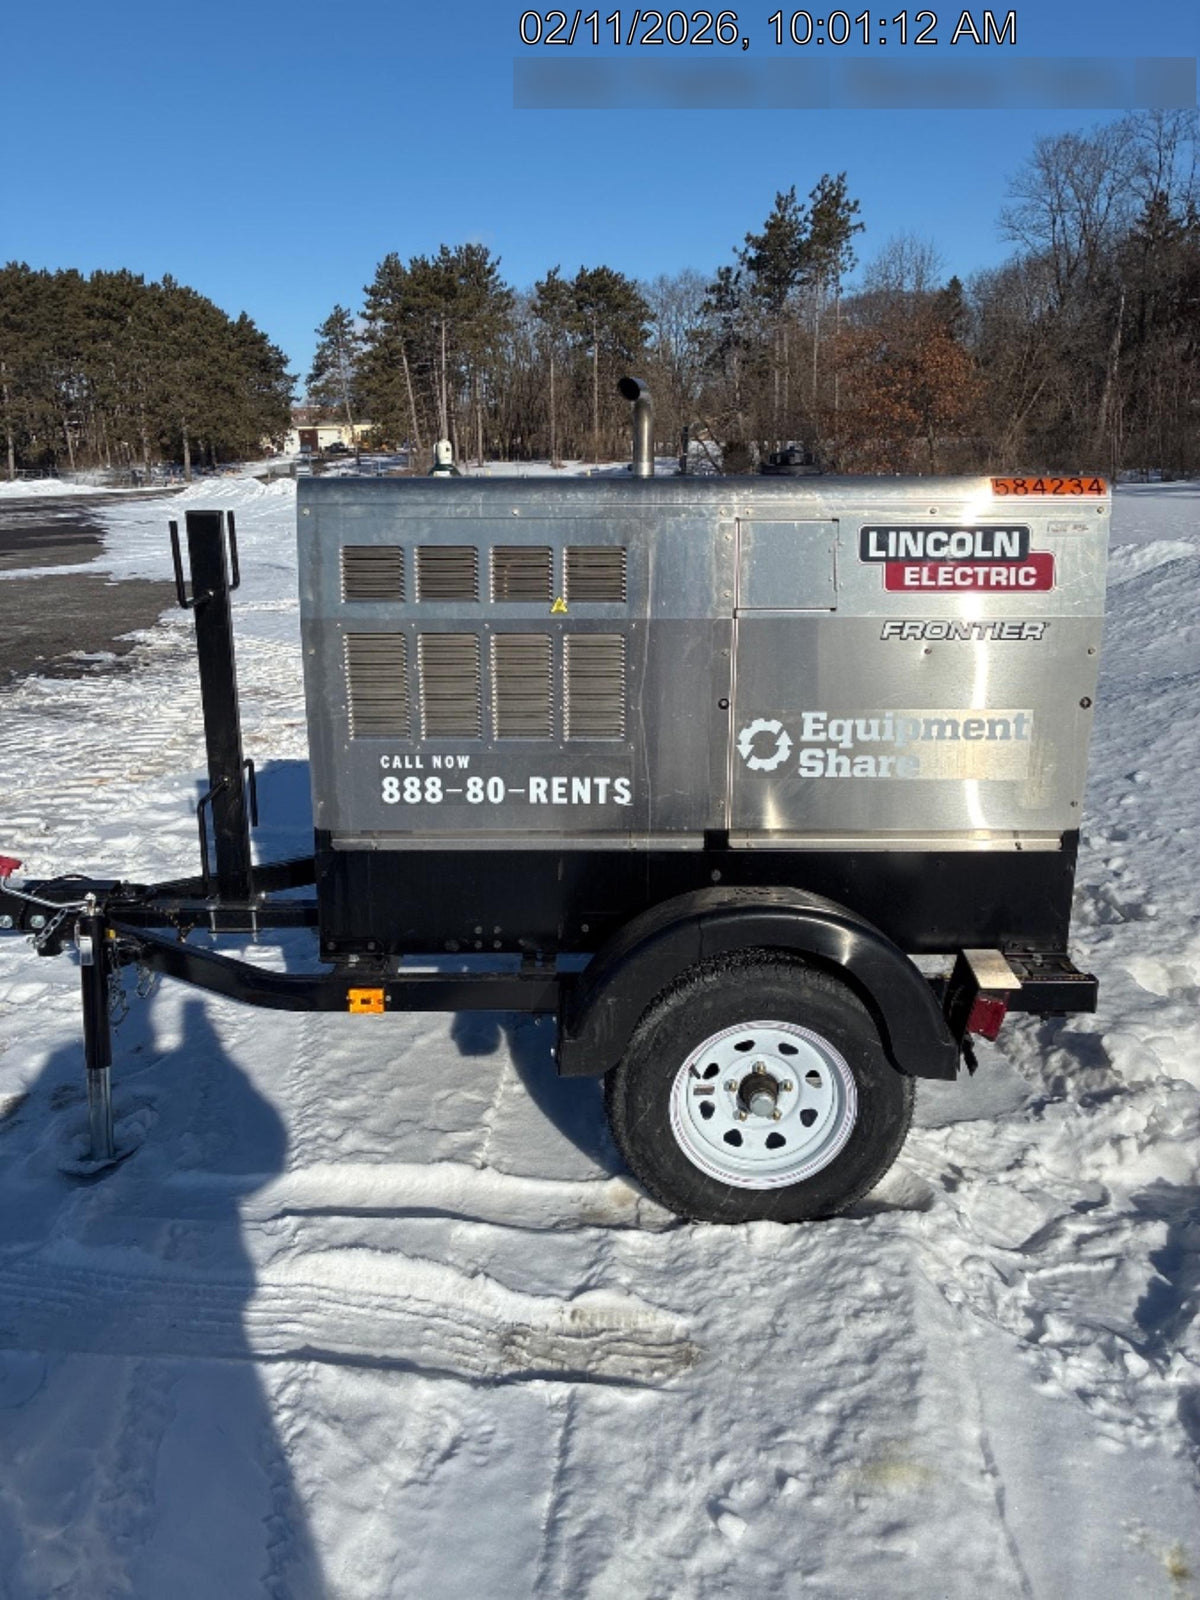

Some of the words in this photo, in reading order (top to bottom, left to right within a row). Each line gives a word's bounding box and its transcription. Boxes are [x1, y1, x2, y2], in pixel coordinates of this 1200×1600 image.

[994, 478, 1103, 496] 584234
[868, 531, 1020, 557] LINCOLN
[904, 567, 1037, 586] ELECTRIC
[880, 620, 1046, 641] FRONTIER
[801, 711, 1032, 748] Equipment
[379, 755, 424, 769] CALL
[432, 755, 470, 769] NOW
[798, 748, 919, 778] Share
[381, 776, 633, 806] 888-80-RENTS
